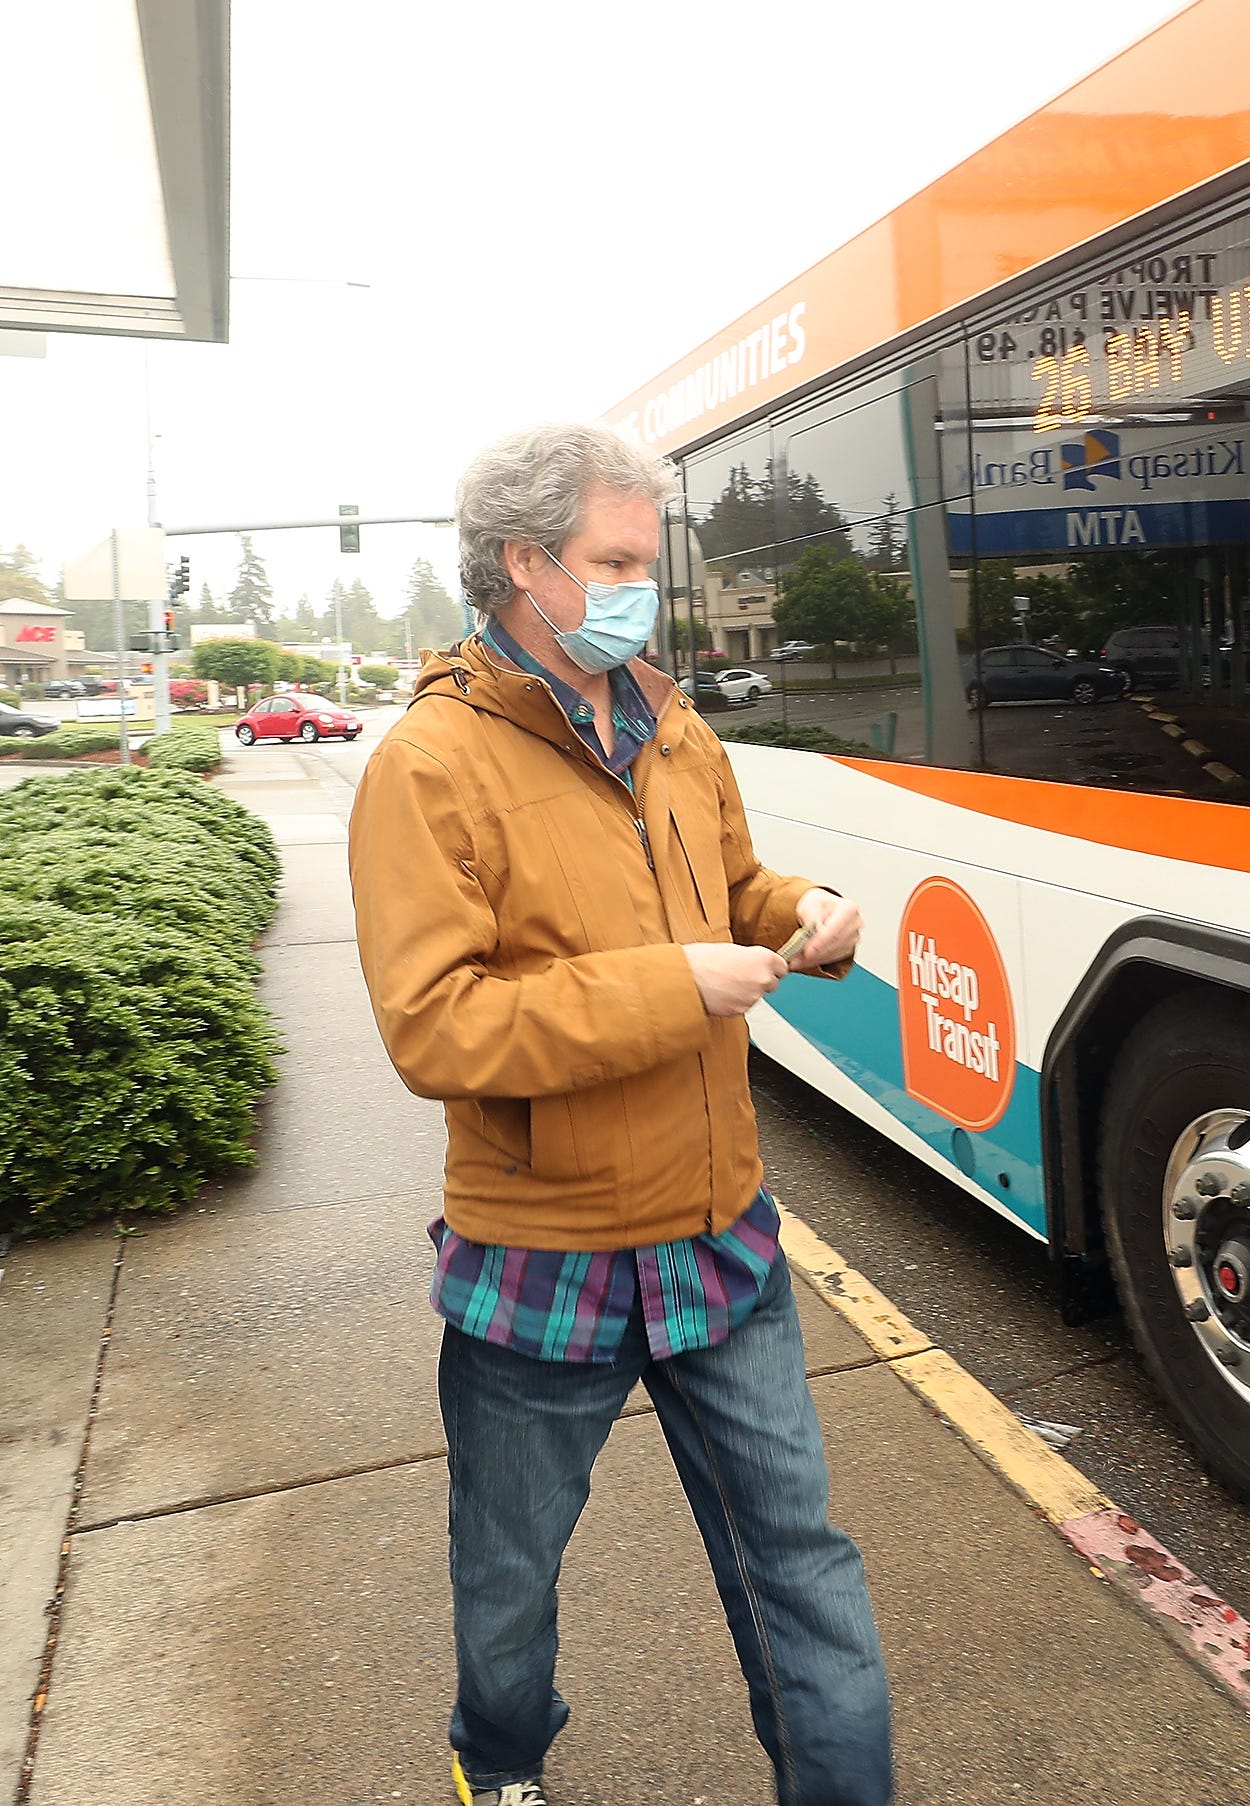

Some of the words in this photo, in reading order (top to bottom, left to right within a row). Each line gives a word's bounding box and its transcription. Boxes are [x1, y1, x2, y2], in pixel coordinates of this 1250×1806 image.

[643, 301, 807, 444] COMMUNITIES
[1031, 343, 1091, 433] 26
[1107, 311, 1190, 401] BAY
[15, 625, 57, 642] ACE
[908, 931, 979, 1022] Kitsap
[921, 993, 1000, 1082] Transit
